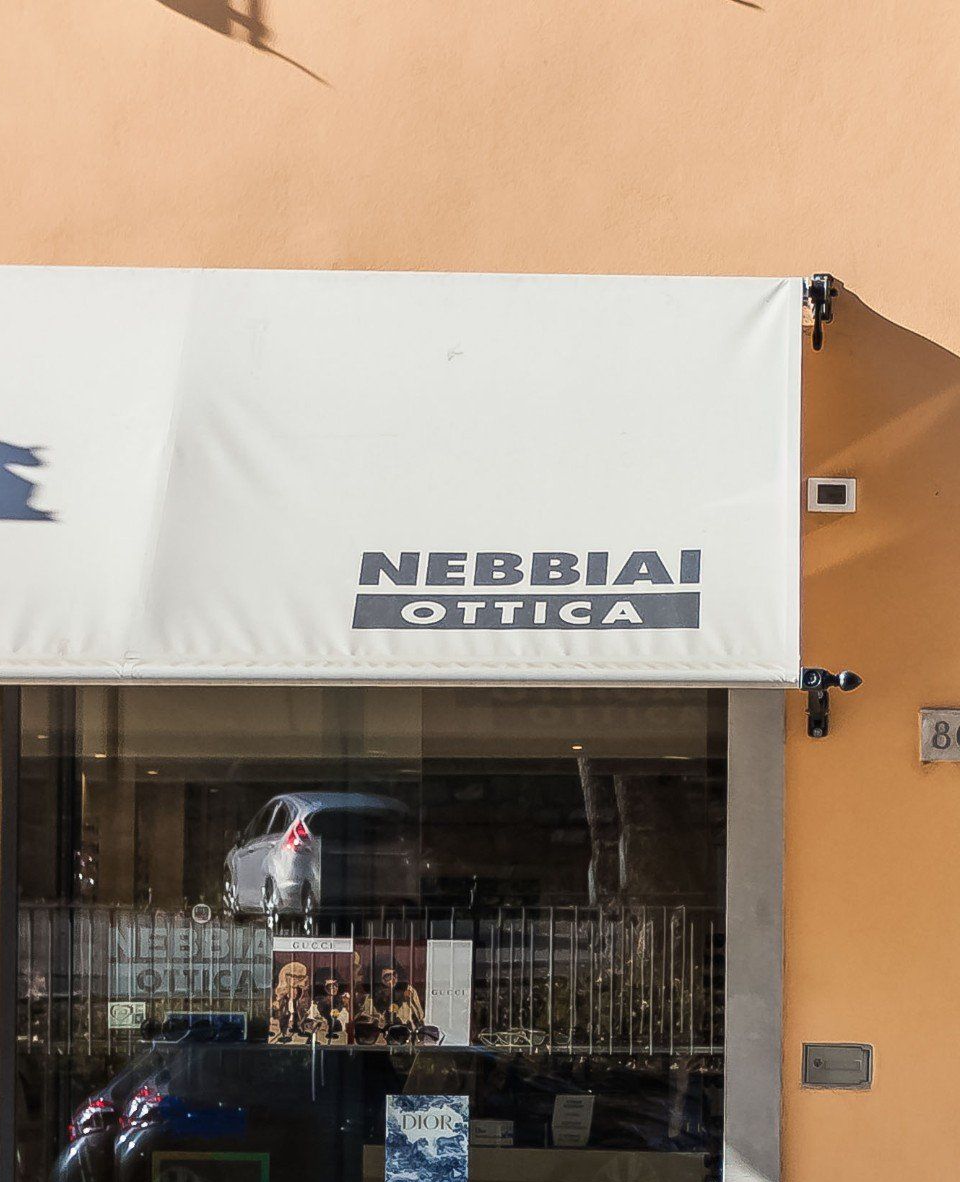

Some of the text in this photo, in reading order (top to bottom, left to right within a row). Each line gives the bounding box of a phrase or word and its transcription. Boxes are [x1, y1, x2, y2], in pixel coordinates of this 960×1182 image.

[358, 549, 702, 586] NEBBIAI
[400, 601, 644, 626] OTTICA
[932, 721, 960, 749] 8
[292, 941, 333, 950] GUCCI
[137, 969, 259, 993] OTTICA
[402, 1114, 453, 1131] DIOR
